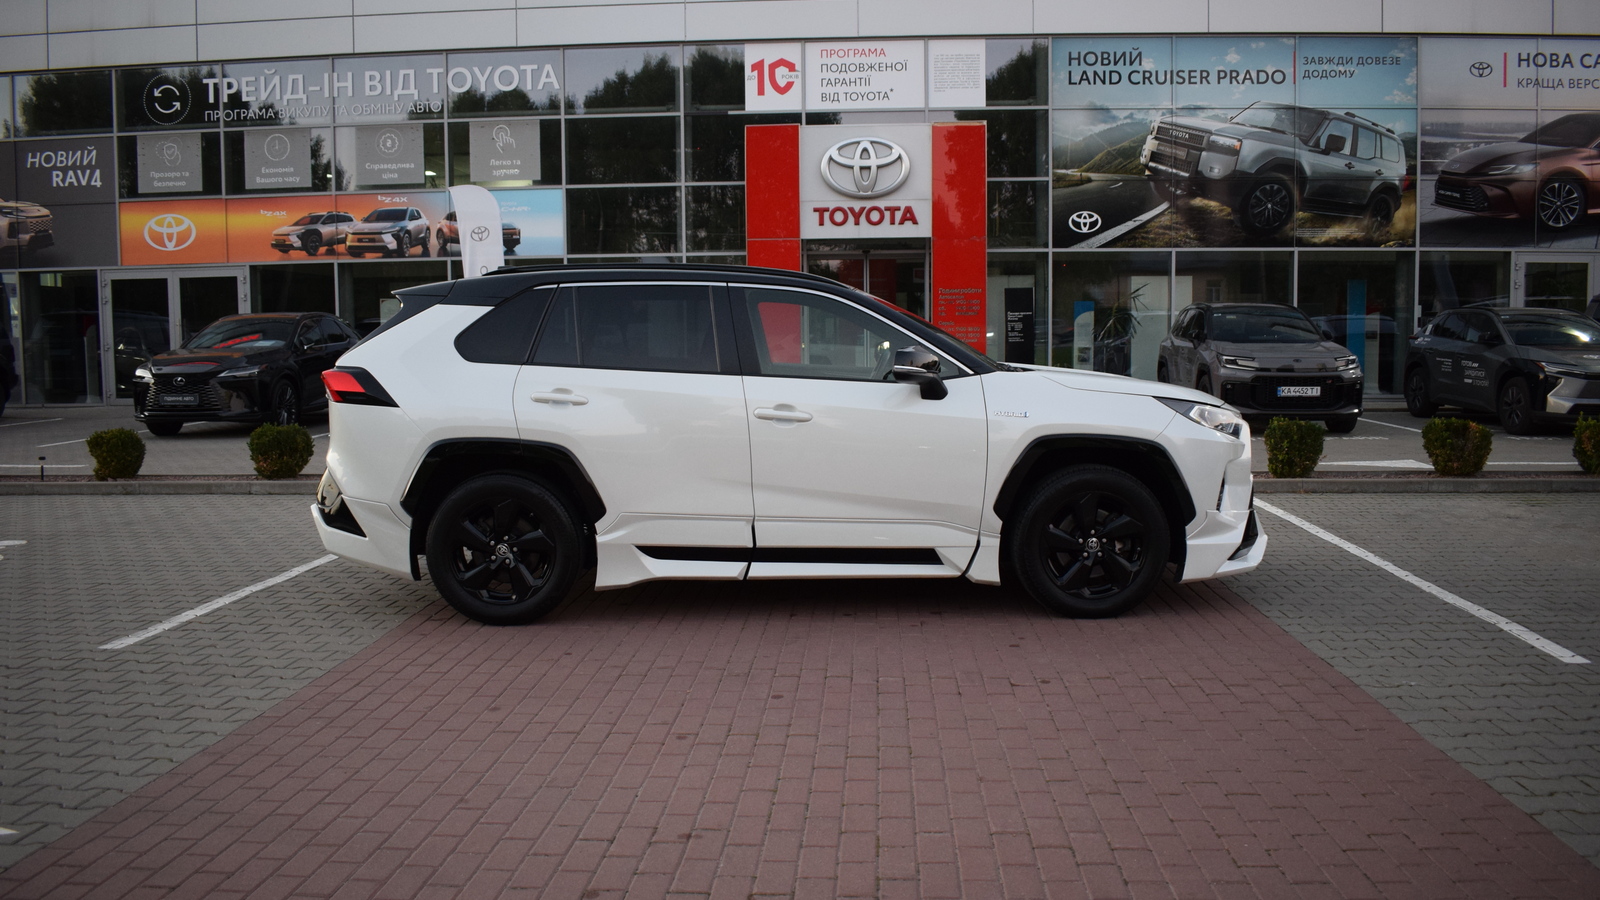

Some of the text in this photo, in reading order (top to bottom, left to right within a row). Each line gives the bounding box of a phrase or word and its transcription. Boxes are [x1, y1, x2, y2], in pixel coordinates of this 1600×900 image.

[820, 48, 887, 59] ПРОГРАМА
[1067, 47, 1143, 67] НОВИЙ
[820, 59, 909, 74] ПОДОВЖЕНОЇ
[1302, 55, 1401, 67] ЗАВЖДИ ДОВЕЗЕ
[1517, 52, 1574, 69] НОВА
[1067, 69, 1287, 86] LAND CRUISER PRADO
[1302, 69, 1356, 81] ДОДОМУ
[202, 63, 560, 105] ТРЕЙД-ІН ВІД TOYOTA
[820, 76, 871, 88] ГАРАНТІЇ
[1517, 78, 1565, 91] КРАЩА
[821, 92, 841, 103] ВІД
[204, 100, 442, 122] ПРОГРАМА ВИКУПУ ТА ОБМІНУ АВТО
[1169, 129, 1189, 139] TOYOTA
[27, 146, 97, 169] НОВИЙ
[489, 158, 510, 167] Легко
[261, 165, 294, 175] Економія
[365, 161, 415, 171] Справедлива
[52, 168, 102, 188] RAV4
[150, 170, 180, 179] Прозоро
[256, 175, 301, 185] Вашого часу
[382, 171, 398, 180] ціна
[153, 179, 187, 188] безпечно
[812, 205, 919, 227] TOYOTA
[1281, 387, 1292, 395] KA
[1292, 387, 1309, 395] 4452
